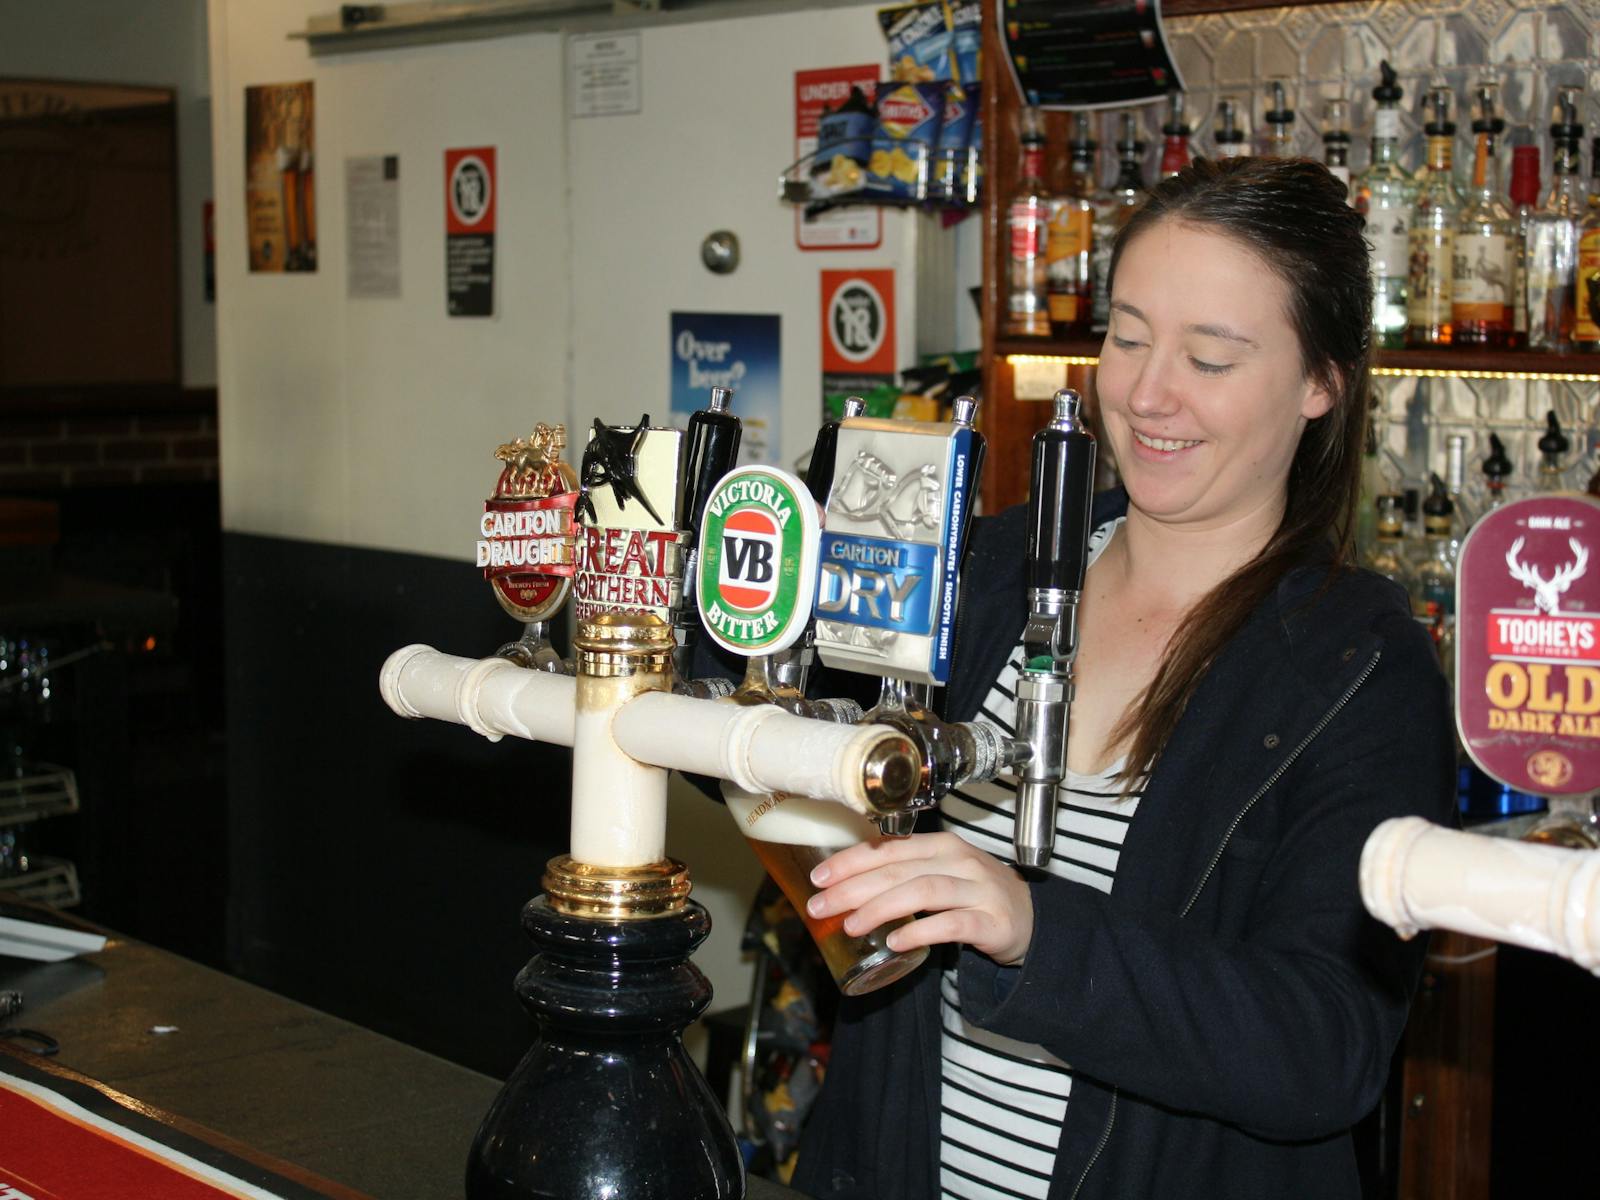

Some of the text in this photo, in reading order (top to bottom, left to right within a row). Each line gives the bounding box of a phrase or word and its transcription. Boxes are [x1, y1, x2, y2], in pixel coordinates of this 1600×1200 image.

[799, 79, 849, 102] UNDER
[677, 330, 732, 361] Over
[689, 361, 747, 391] beer?
[709, 480, 793, 530] VICTORIA
[480, 509, 561, 538] CARLTON
[476, 537, 566, 568] DRAUGHT
[575, 527, 679, 578] GREAT
[722, 535, 774, 583] VB
[830, 540, 900, 567] CARLTON
[939, 454, 965, 660] LOWER CARBOHYDRATES SMOOTH FINISH
[817, 561, 923, 622] DRY
[706, 600, 780, 641] BITTER
[1496, 617, 1595, 650] TOOHEYS
[1485, 661, 1600, 715] OLD
[1488, 708, 1600, 738] DARK ALE
